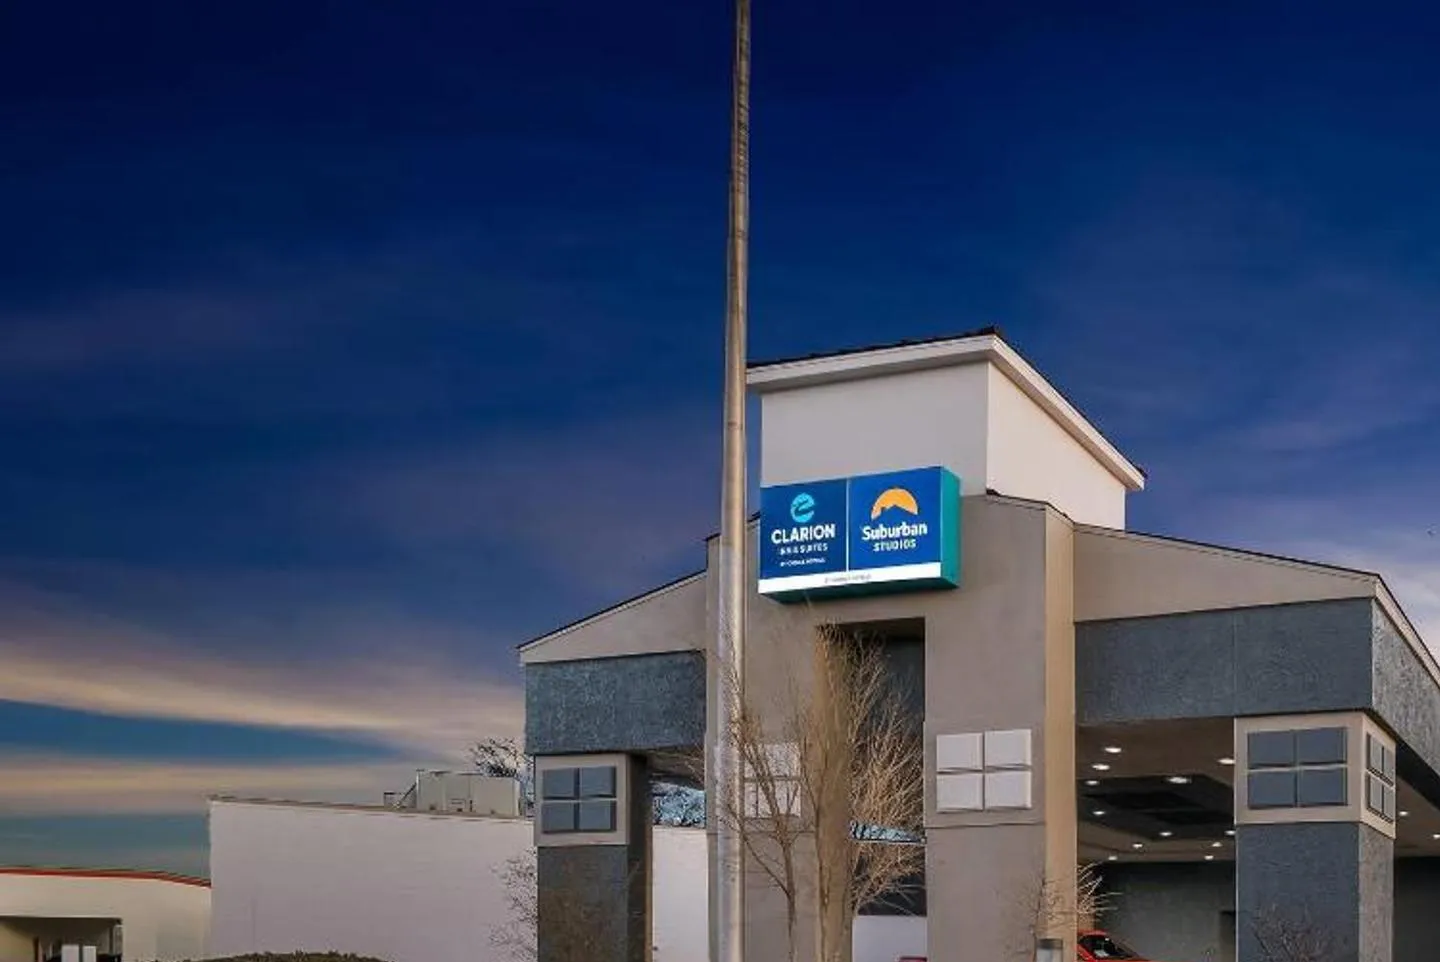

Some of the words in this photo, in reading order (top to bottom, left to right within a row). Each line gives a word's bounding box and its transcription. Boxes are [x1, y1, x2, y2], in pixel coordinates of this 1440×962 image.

[771, 524, 836, 544] CLARION
[861, 522, 928, 540] Suburban
[873, 539, 917, 552] STUDIOS
